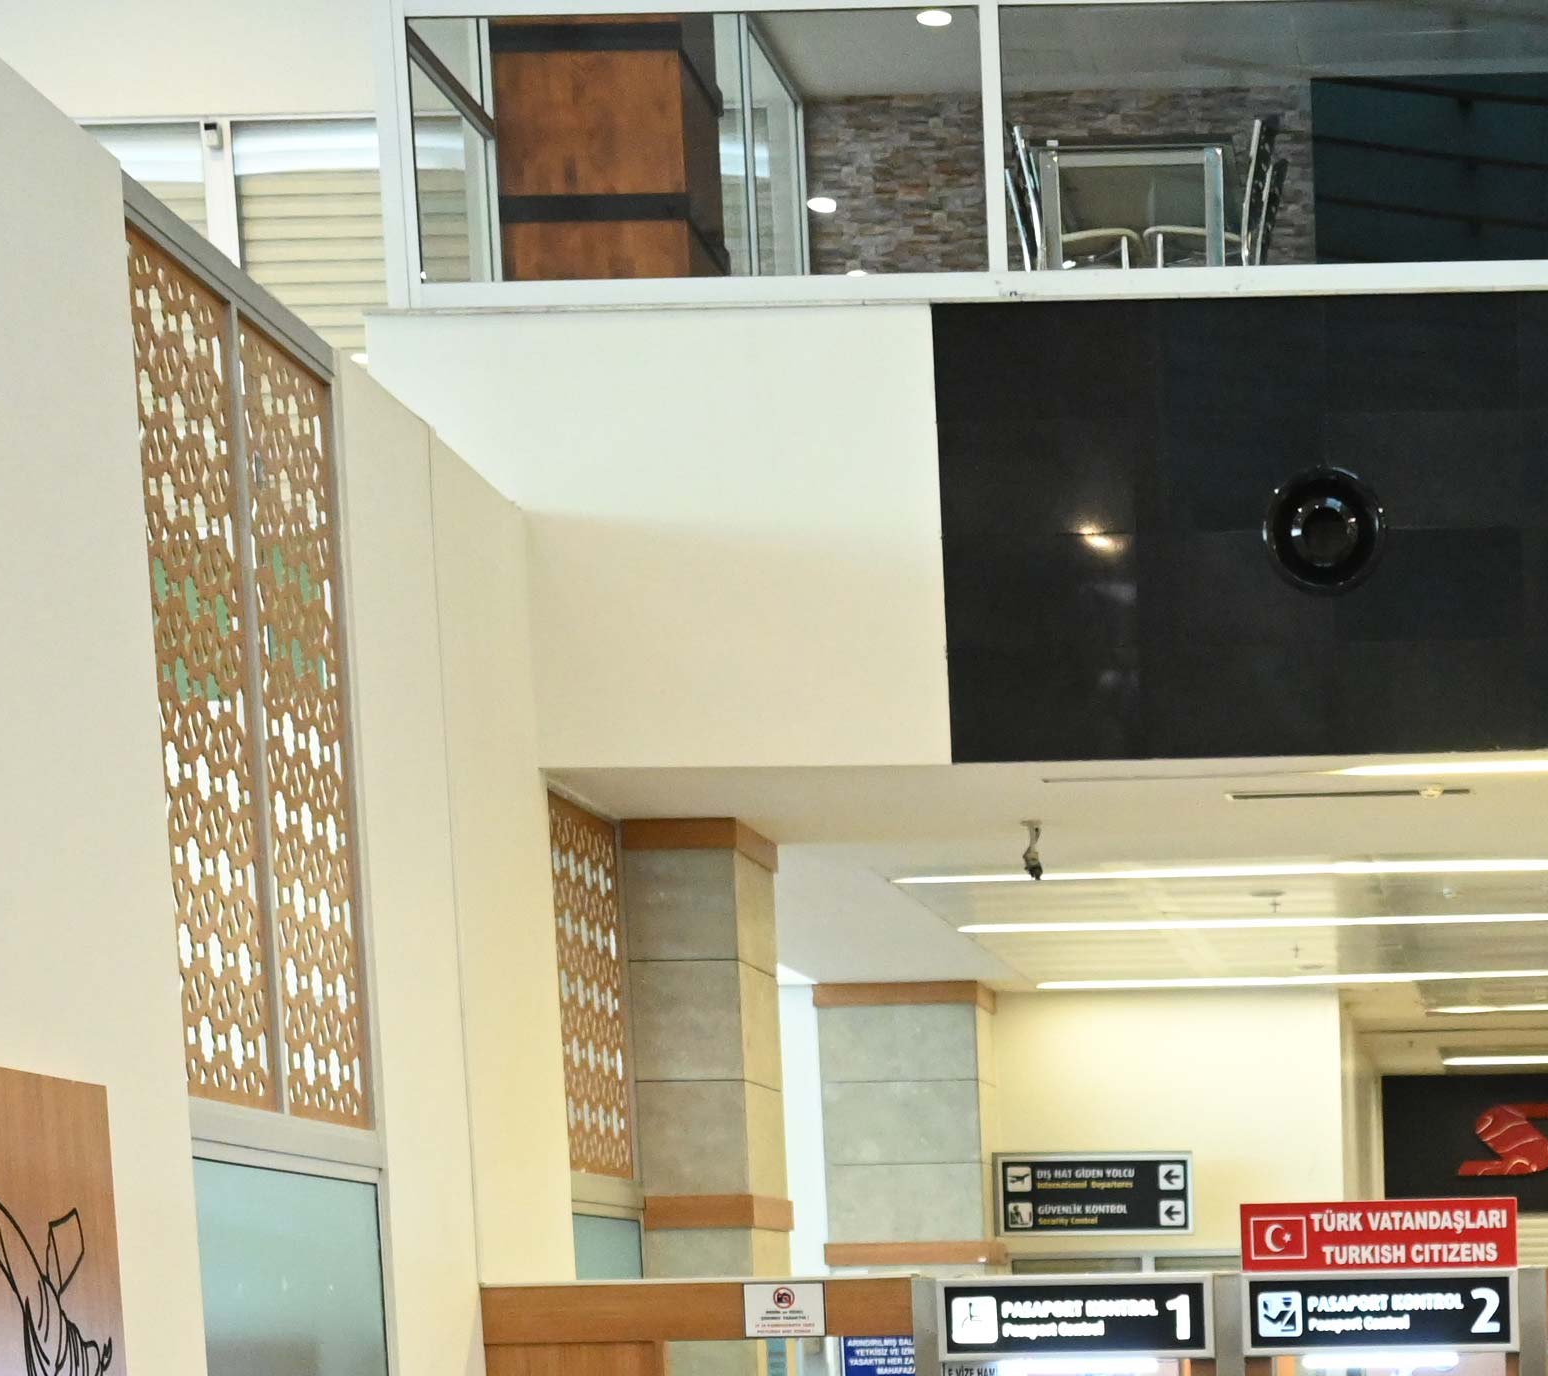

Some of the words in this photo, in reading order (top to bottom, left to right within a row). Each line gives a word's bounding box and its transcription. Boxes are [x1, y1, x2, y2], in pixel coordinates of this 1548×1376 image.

[1075, 1167, 1103, 1178] GİDEN
[1106, 1168, 1134, 1178] YOLCU
[1038, 1203, 1082, 1215] GÜVENLİK
[1085, 1205, 1127, 1214] KONTROL
[1310, 1210, 1363, 1232] TÜRK
[1367, 1210, 1507, 1234] VATANDAŞLARI
[1322, 1245, 1406, 1265] TURKISH
[1411, 1243, 1498, 1263] CITIZENS
[1166, 1294, 1190, 1340] 1
[1307, 1295, 1389, 1312] PASAPORT
[1470, 1287, 1500, 1333] 2
